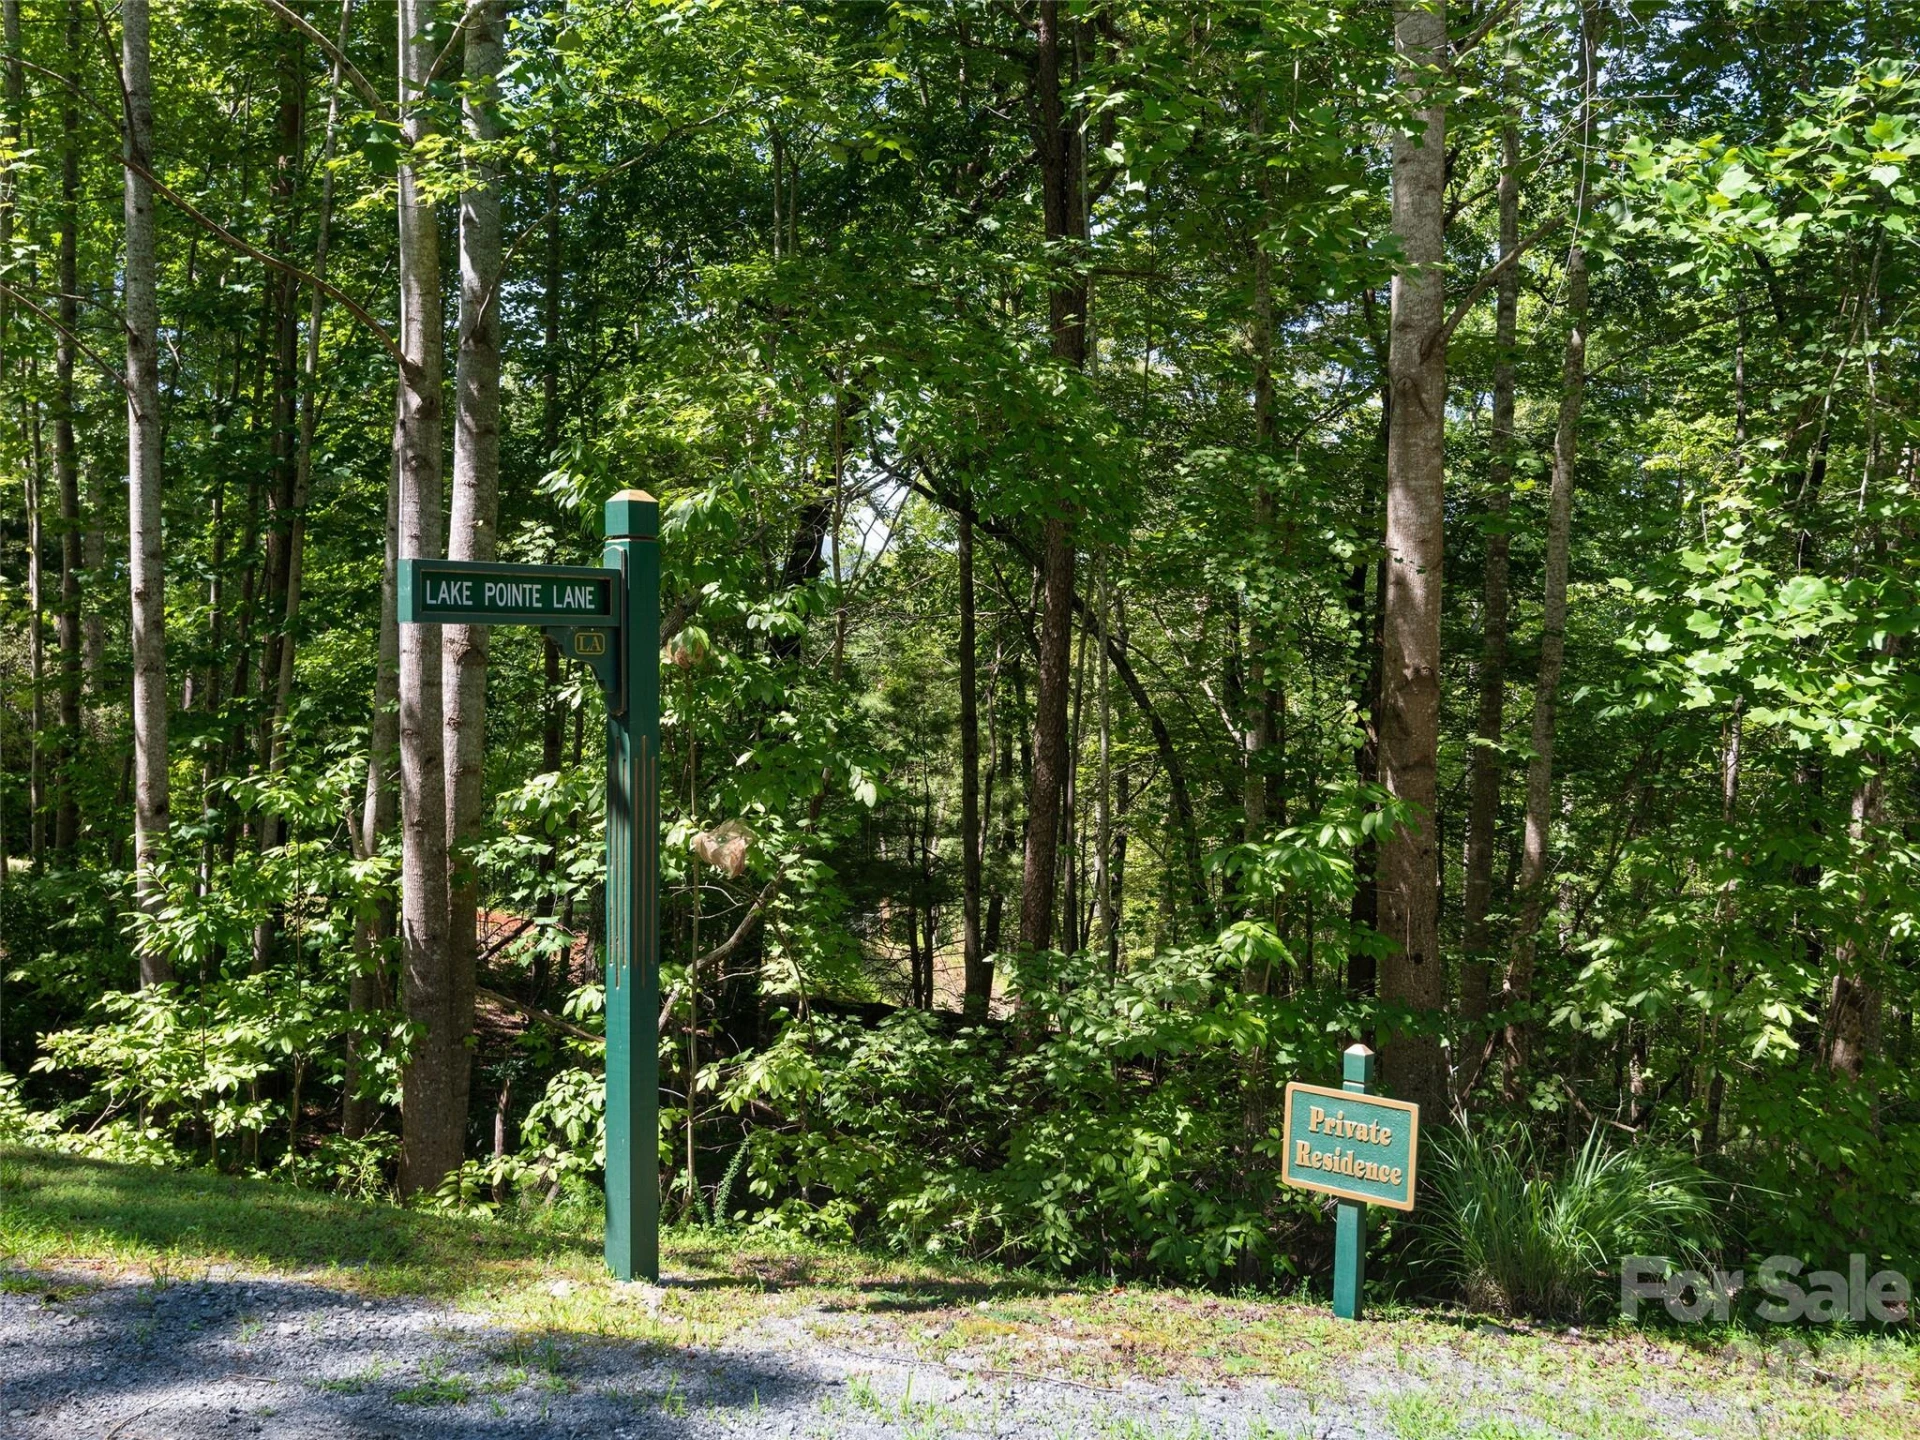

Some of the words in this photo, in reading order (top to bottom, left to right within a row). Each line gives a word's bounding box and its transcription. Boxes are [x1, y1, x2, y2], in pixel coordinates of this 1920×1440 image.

[426, 580, 473, 606] LAKE
[485, 582, 542, 608] POINTE
[553, 585, 595, 609] LANE
[1308, 1105, 1392, 1146] Private
[1294, 1139, 1402, 1185] Residence
